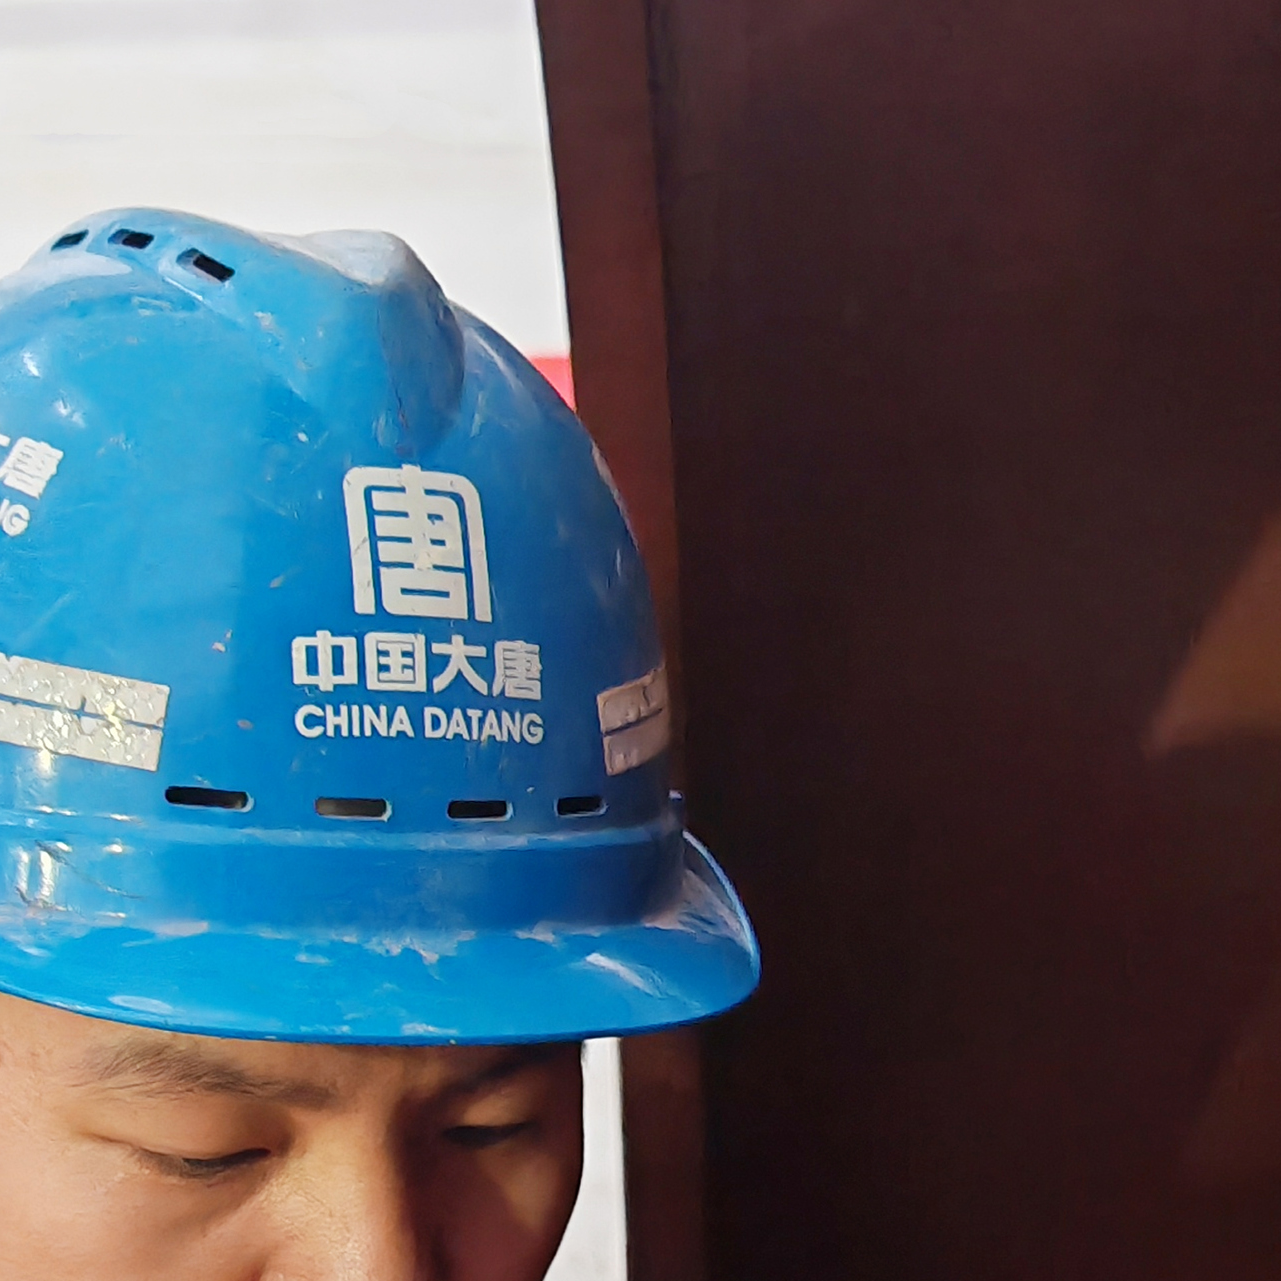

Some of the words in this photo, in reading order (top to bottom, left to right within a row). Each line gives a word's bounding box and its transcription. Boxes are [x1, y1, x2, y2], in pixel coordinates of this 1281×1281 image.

[291, 630, 542, 700] 中国大唐
[294, 704, 415, 739] CHINA
[423, 706, 544, 745] DATANG
